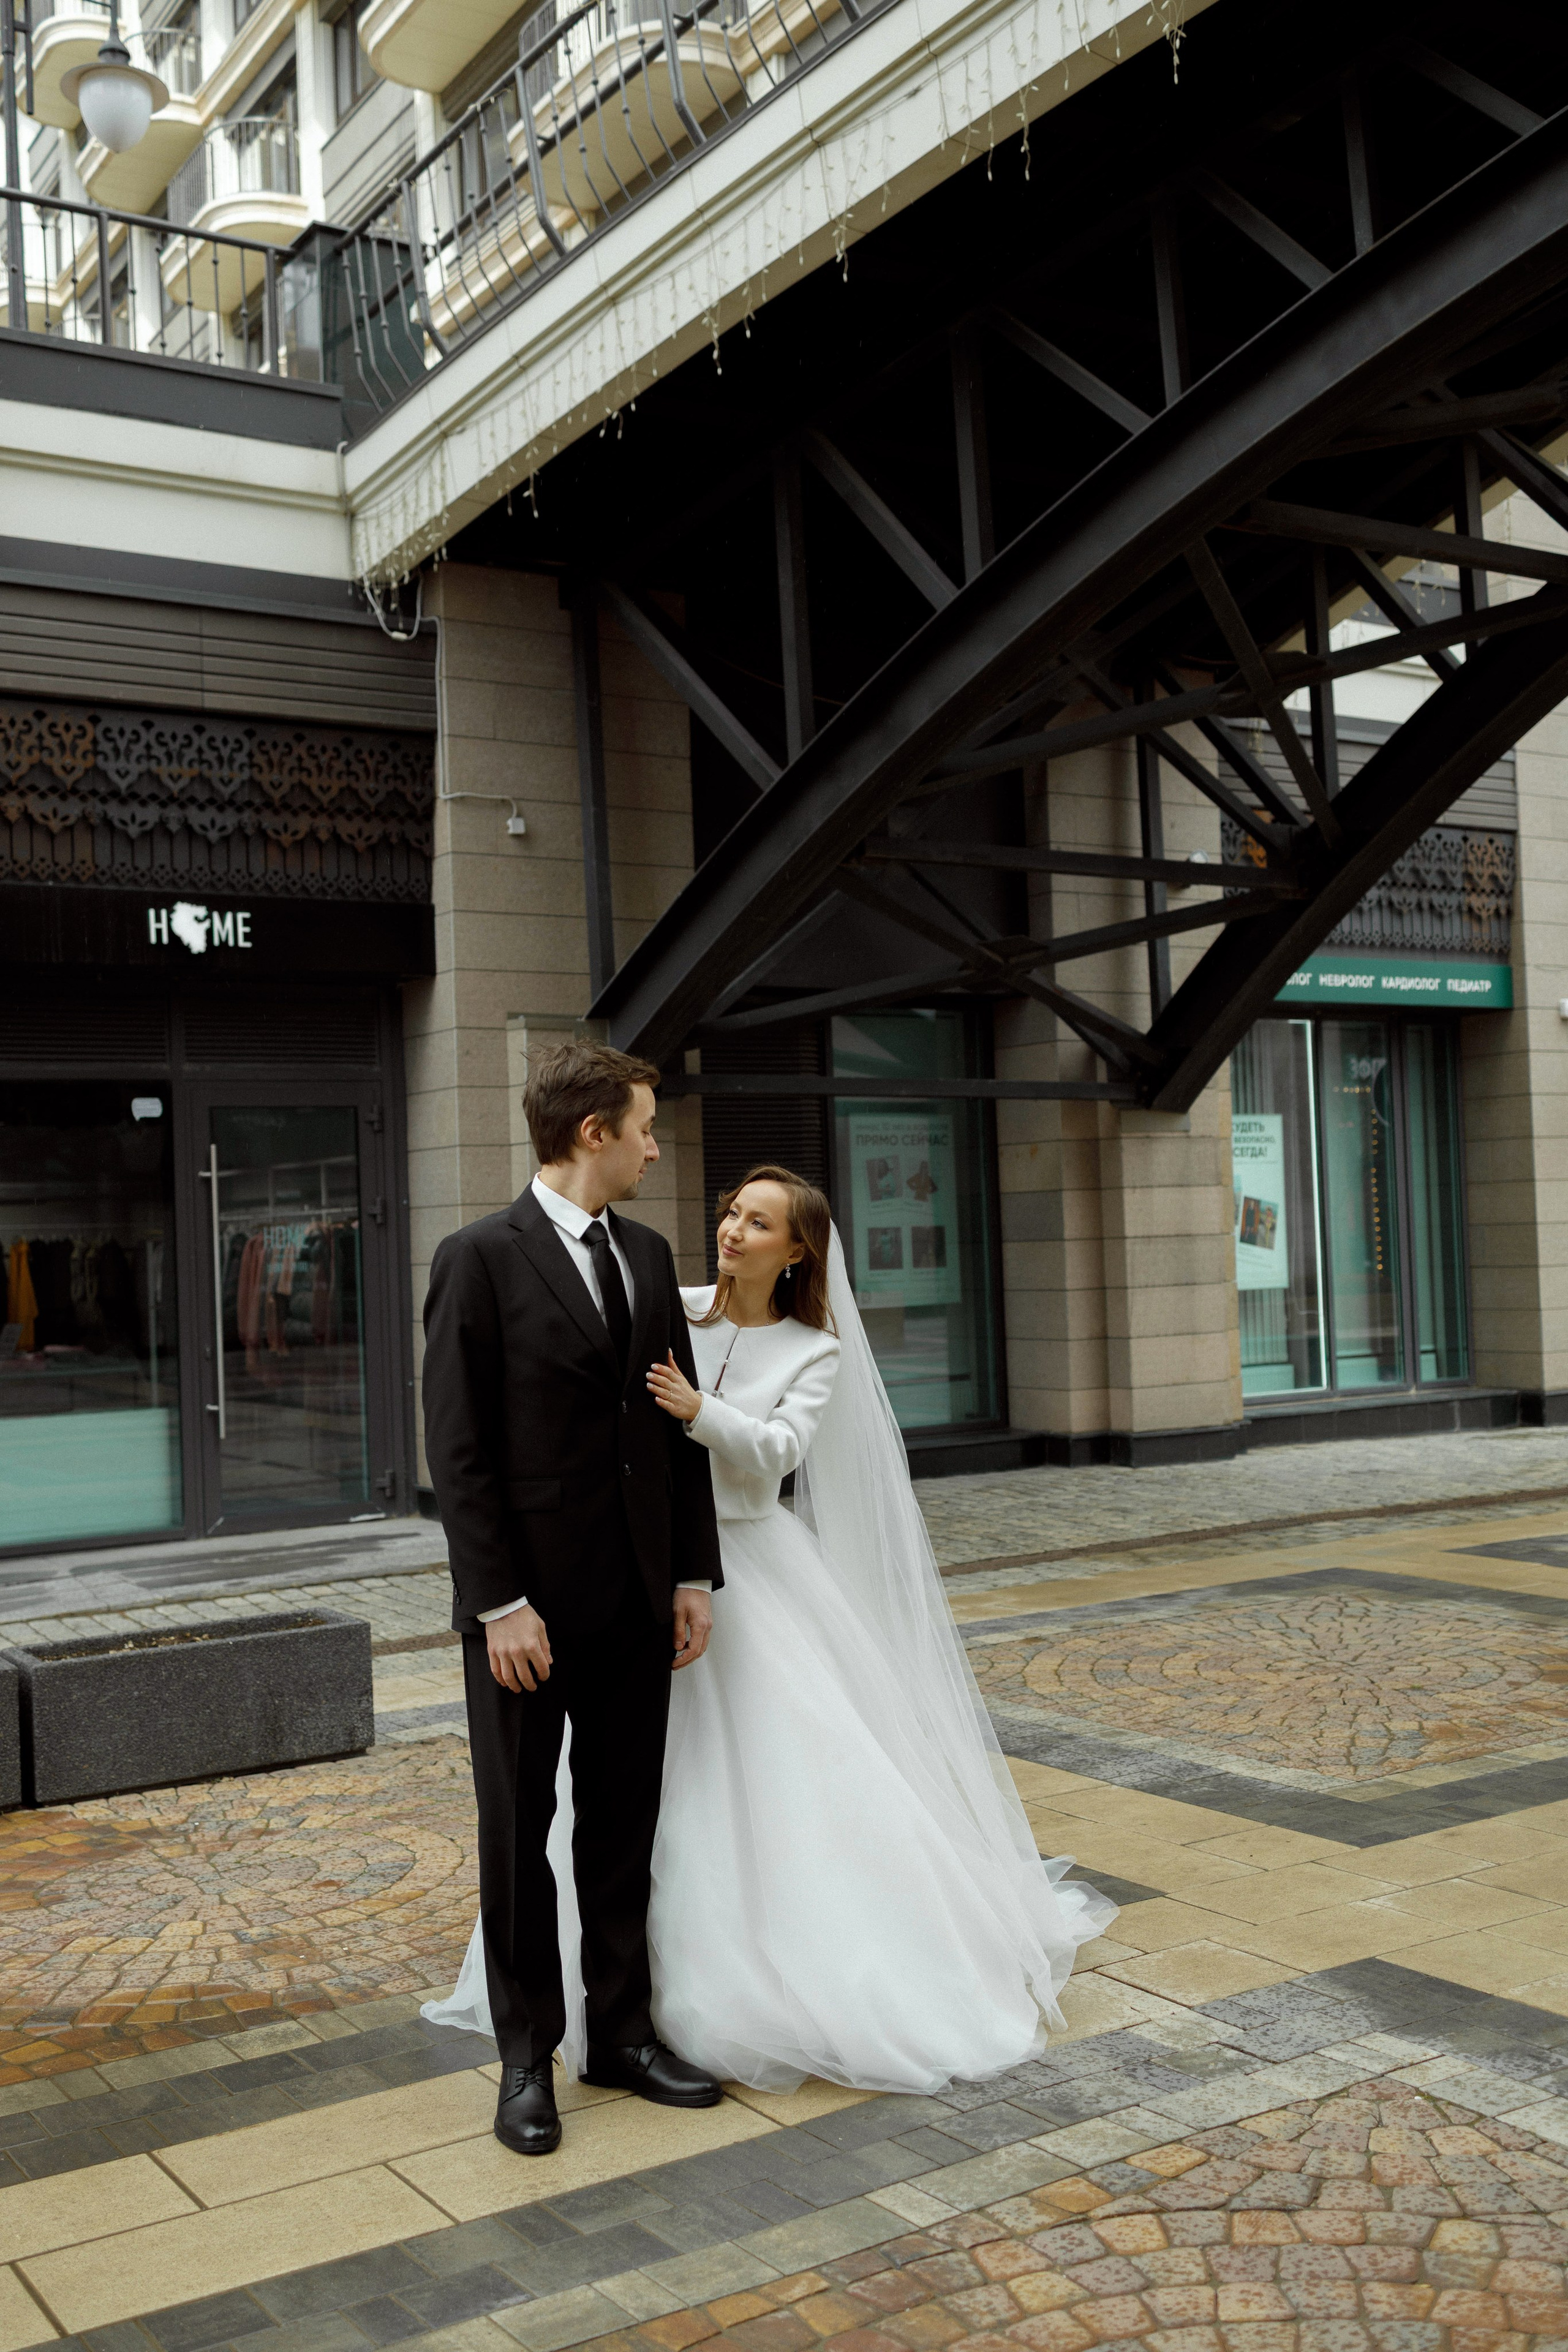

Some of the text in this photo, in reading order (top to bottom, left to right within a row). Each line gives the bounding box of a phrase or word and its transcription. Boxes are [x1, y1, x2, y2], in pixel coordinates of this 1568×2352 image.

[1319, 973, 1375, 989] НЕВРОЛОГ
[1381, 976, 1441, 990] КАРДИОЛОГ
[1447, 978, 1492, 993] ПЕДИАТР
[856, 1133, 949, 1147] ПРЯМО СЕЙЧАС
